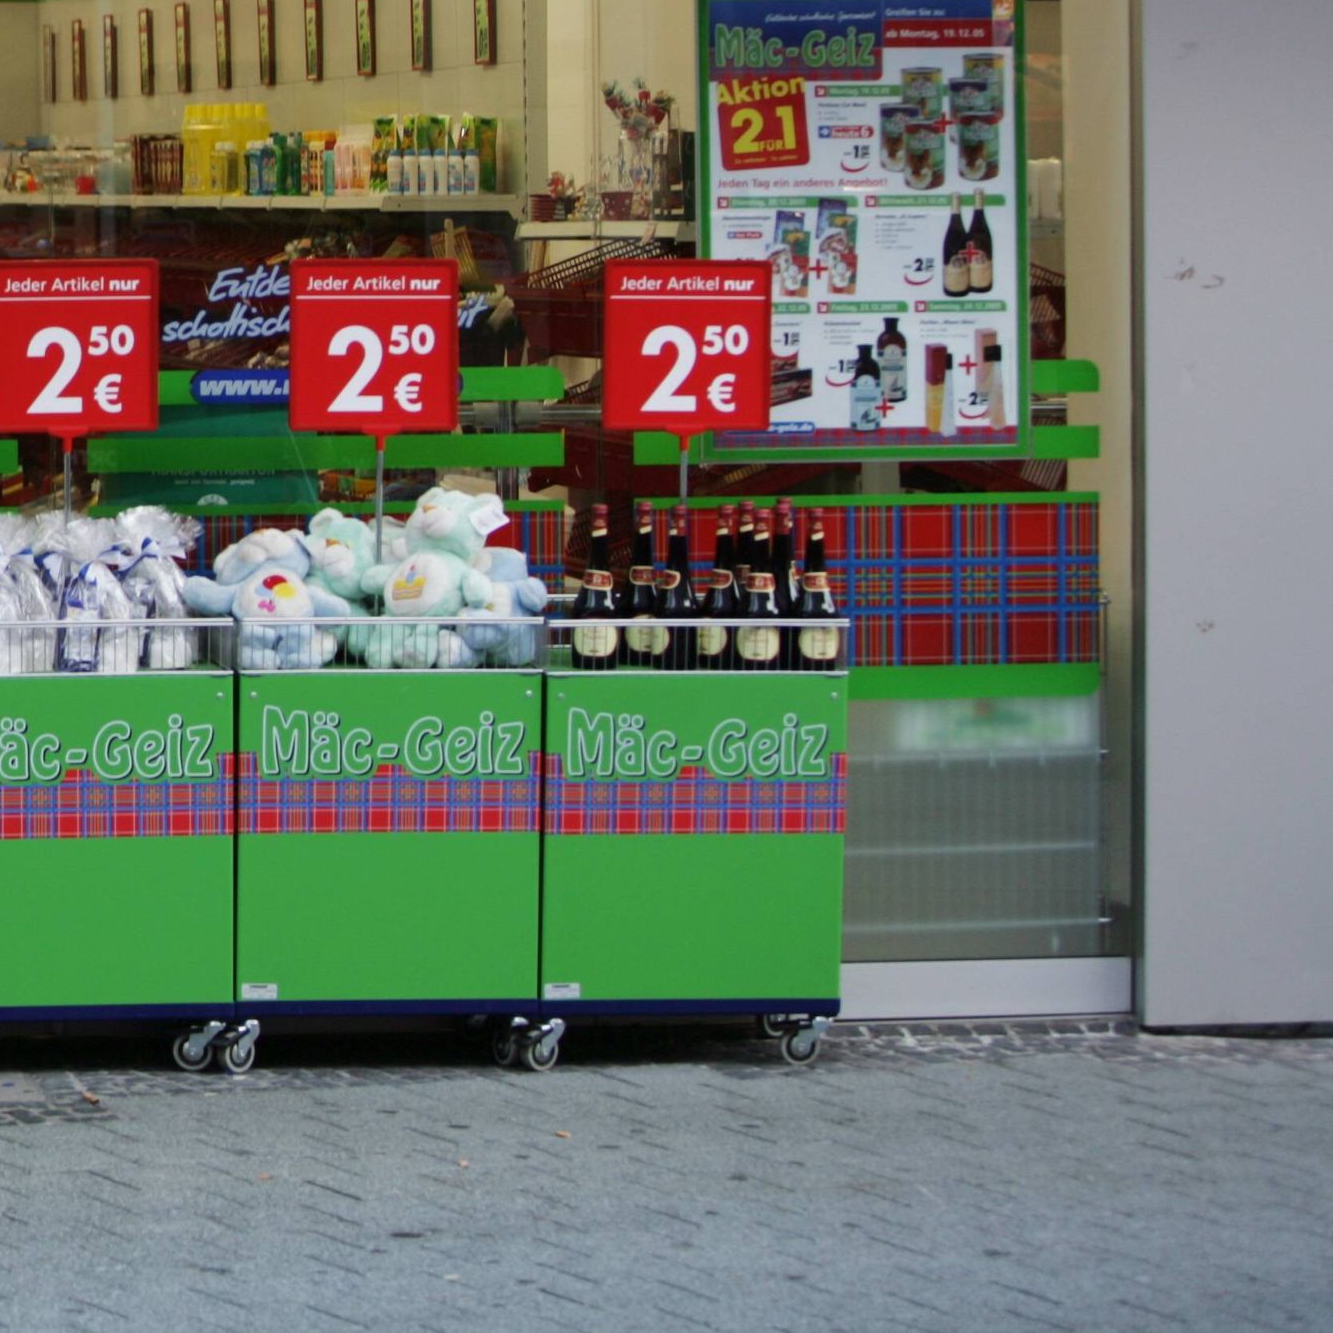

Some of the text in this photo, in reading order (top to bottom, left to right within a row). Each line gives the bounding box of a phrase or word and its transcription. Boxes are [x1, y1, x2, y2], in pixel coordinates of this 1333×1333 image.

[714, 23, 876, 67] Mäc-Geiz
[717, 77, 806, 105] Aktion
[731, 107, 764, 154] 2
[775, 105, 797, 150] 1
[717, 178, 749, 188] Jeden
[752, 179, 771, 190] Tag
[773, 178, 789, 187] ein
[793, 178, 835, 187] anderes
[5, 277, 140, 293] Jeder Artikel nur
[208, 265, 290, 301] Entde
[307, 276, 441, 291] Jeder Artikel nur
[621, 276, 755, 291] Jeder Artikel nur
[162, 302, 290, 341] schottisch
[93, 373, 123, 414] €
[393, 372, 423, 413] €
[707, 372, 736, 413] €
[261, 705, 526, 777] Mäc-Geiz
[566, 706, 829, 779] Mäc-Geiz
